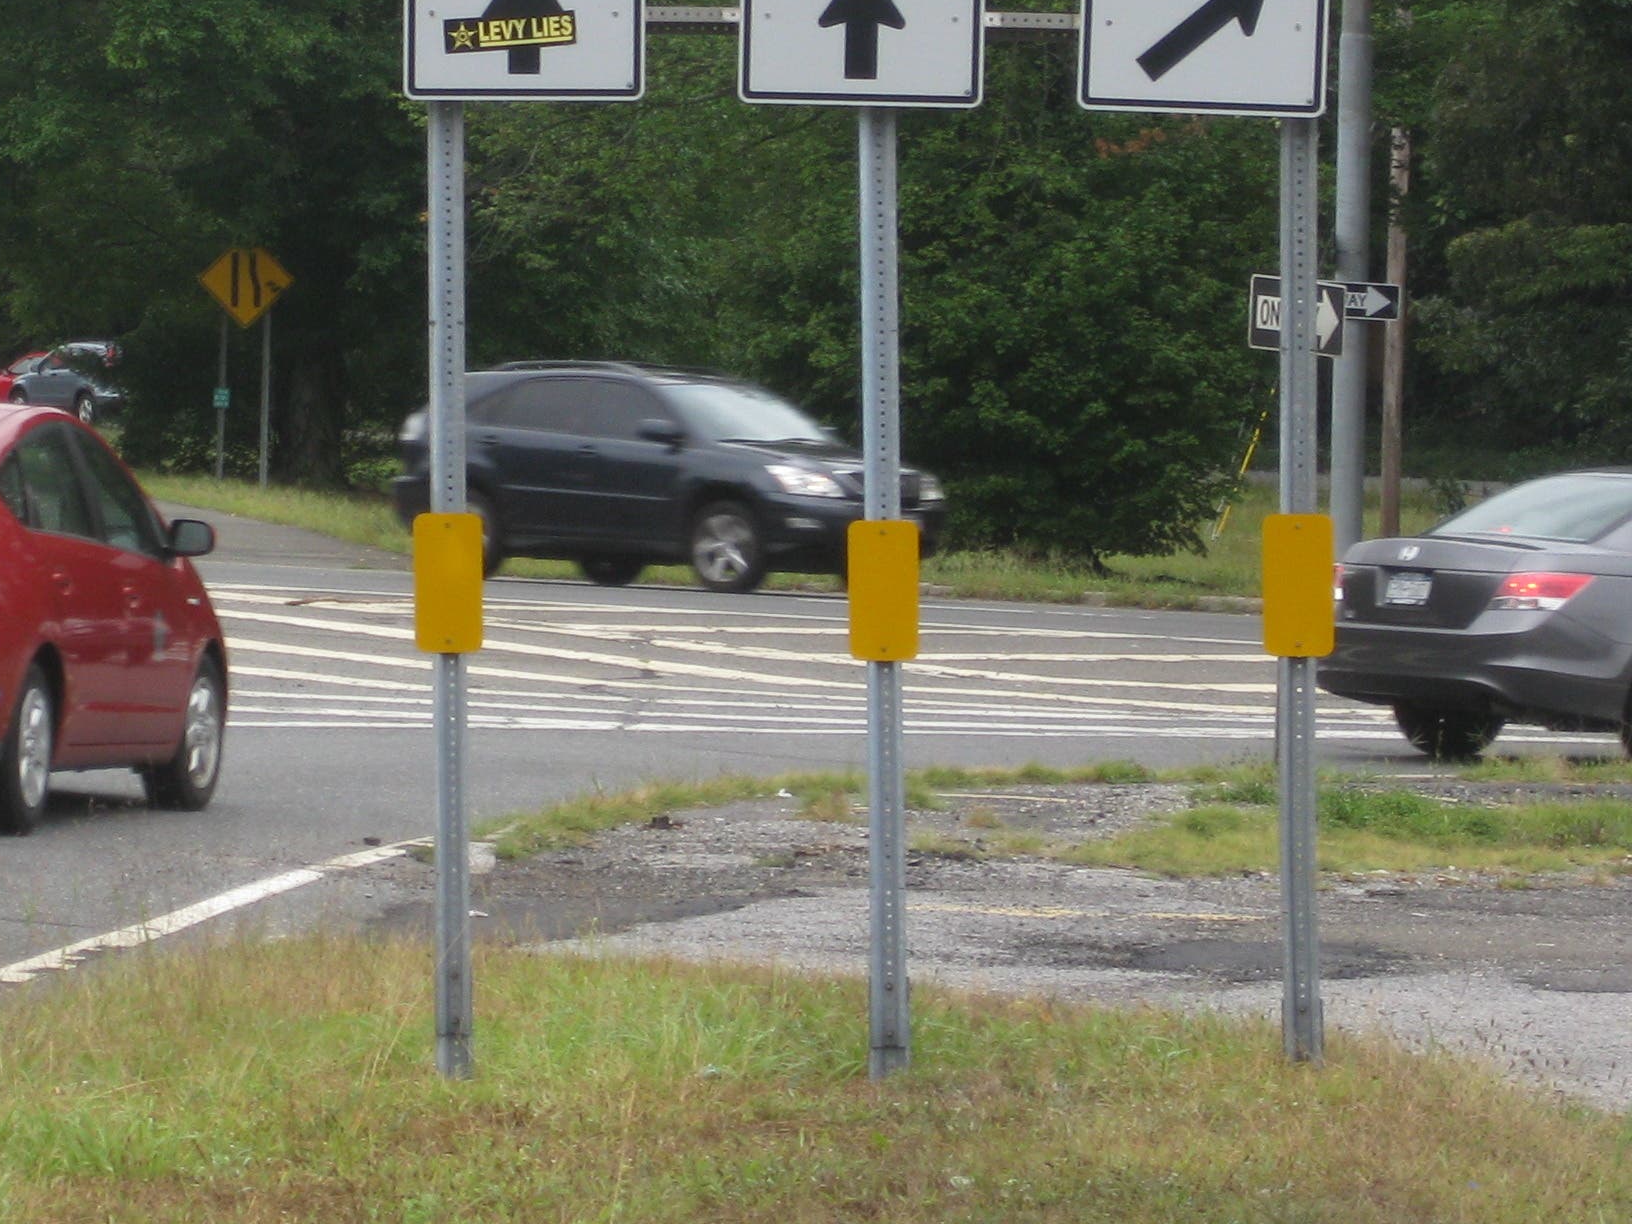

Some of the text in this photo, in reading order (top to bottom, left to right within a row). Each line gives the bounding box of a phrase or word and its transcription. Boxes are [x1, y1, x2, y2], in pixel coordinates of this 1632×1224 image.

[478, 15, 573, 41] LEVY LIES
[1260, 298, 1280, 327] ON
[1345, 293, 1367, 307] AY
